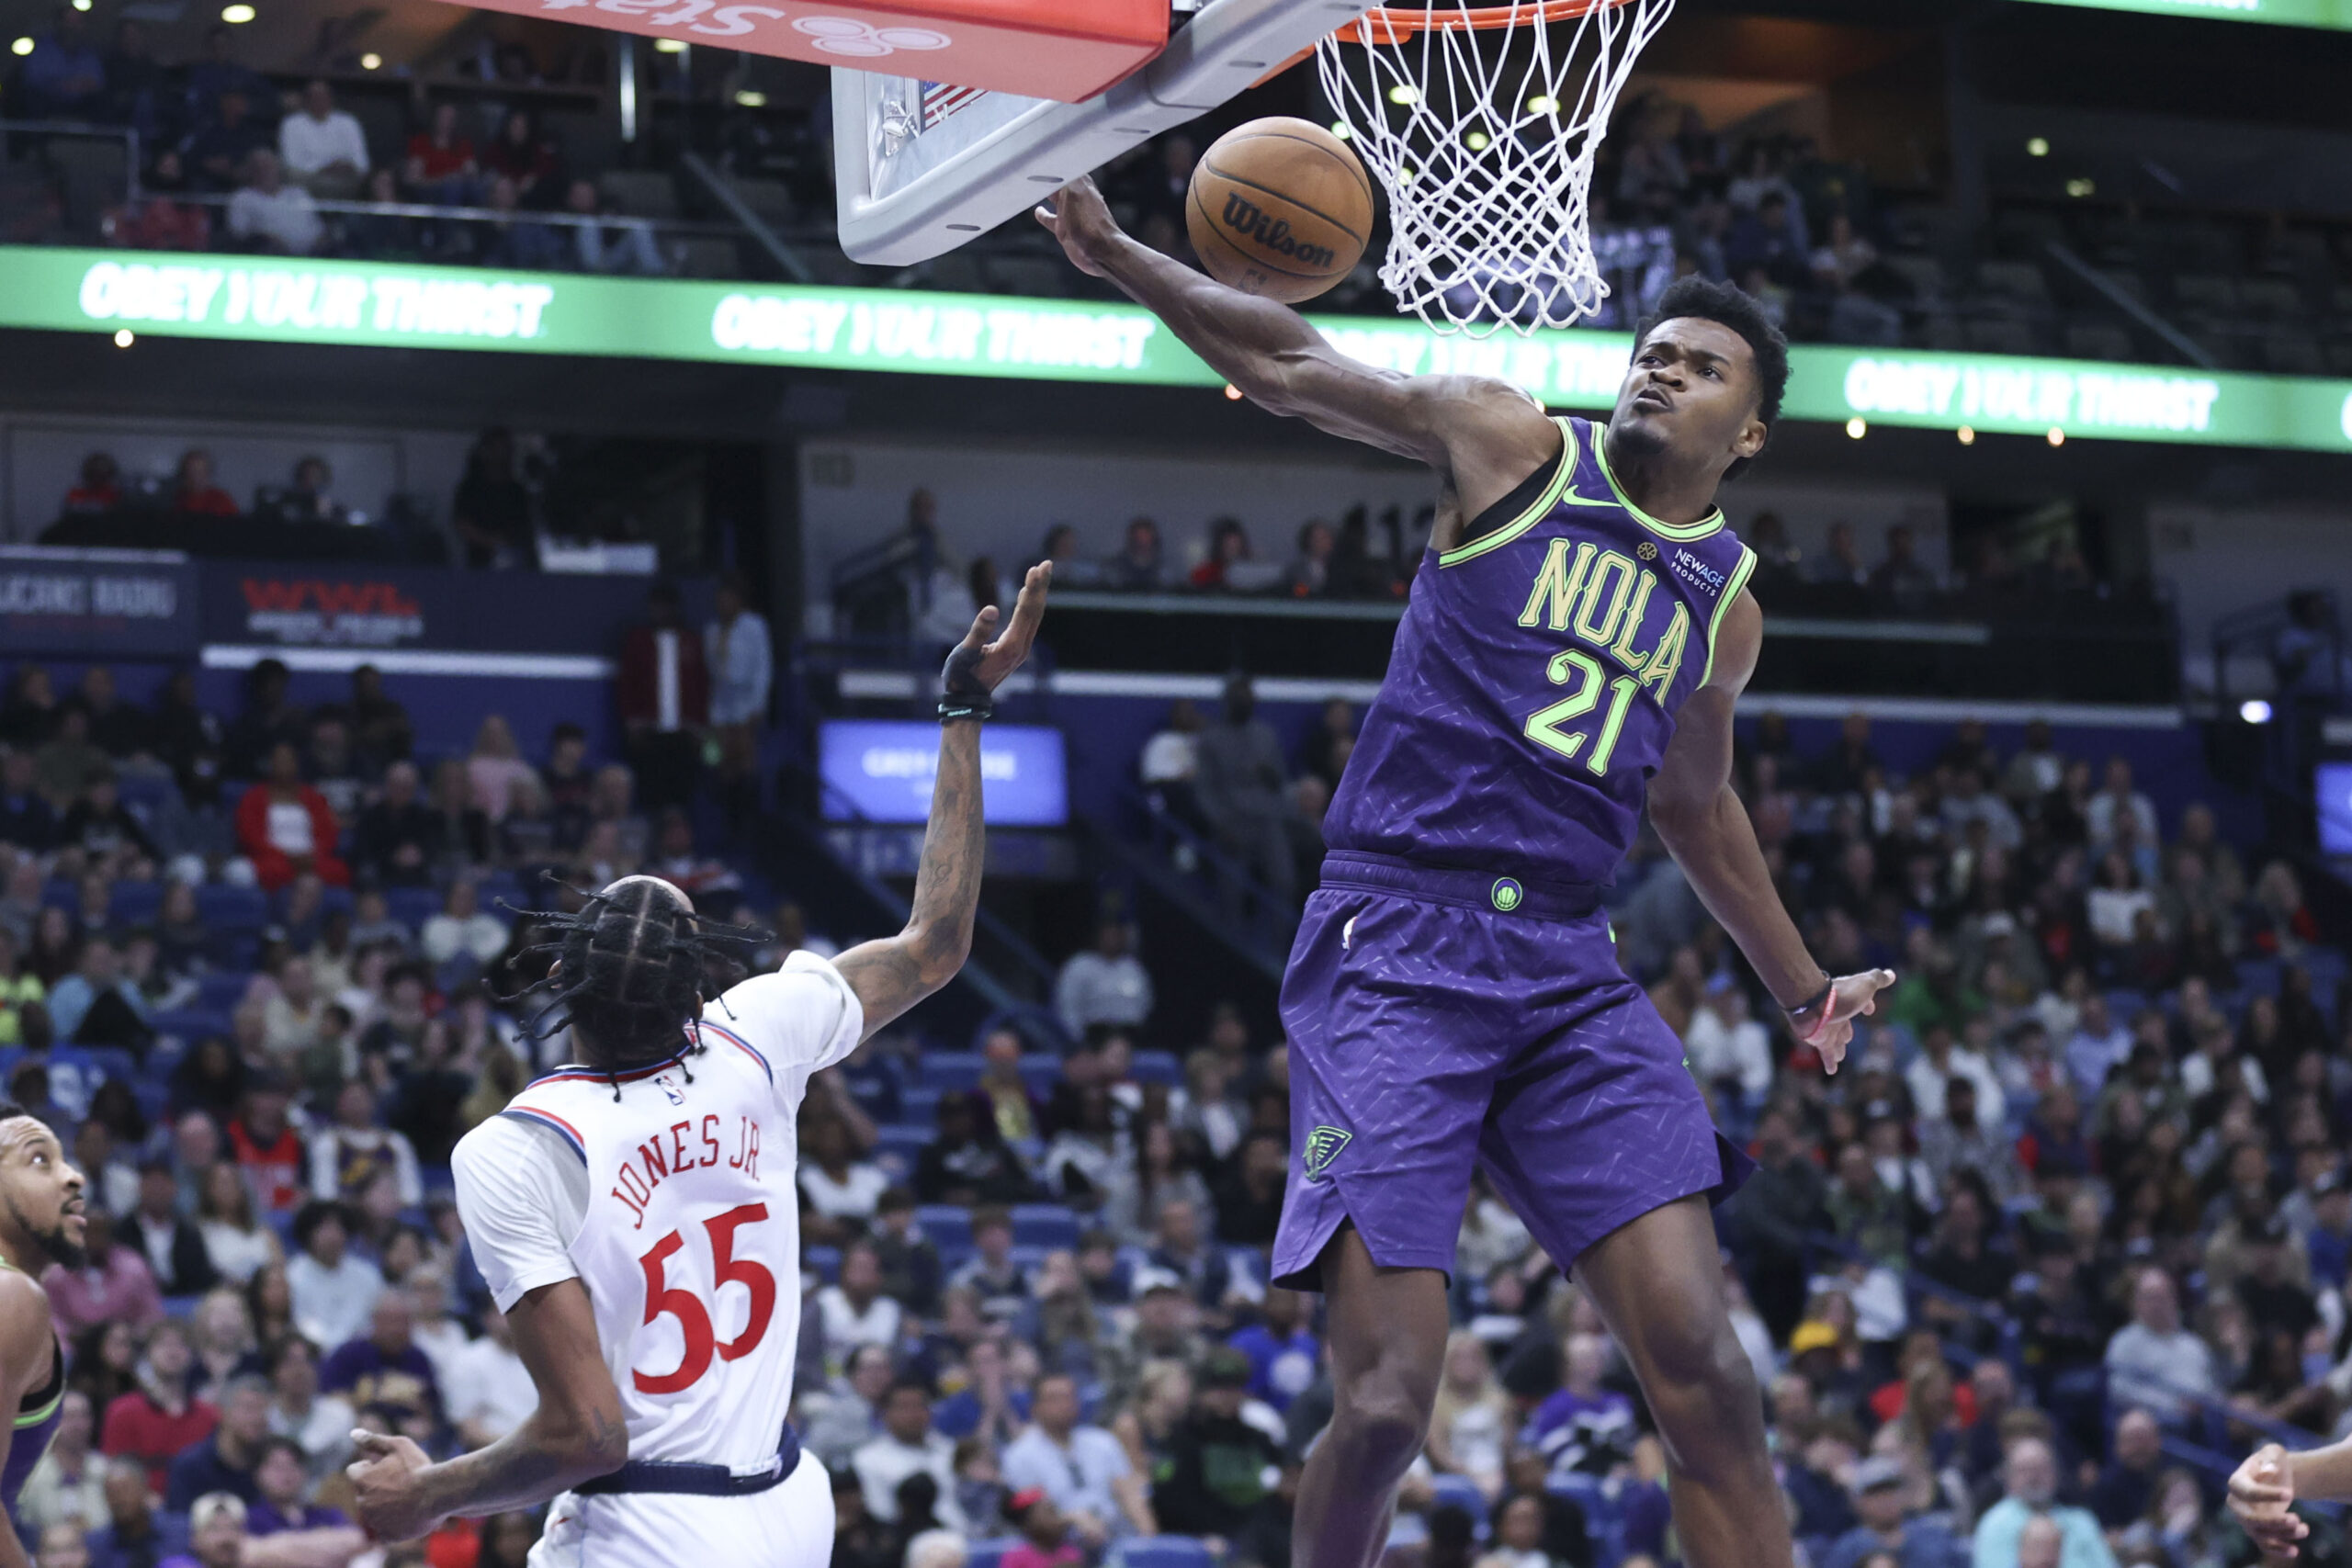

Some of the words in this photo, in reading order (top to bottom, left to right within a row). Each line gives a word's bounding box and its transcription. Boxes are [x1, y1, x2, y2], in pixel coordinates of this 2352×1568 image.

[1223, 190, 1335, 268] Wilson
[79, 261, 223, 323] OBEY
[371, 278, 553, 338] THIRST
[711, 293, 849, 354] OBEY
[984, 310, 1155, 369] THIRST
[1844, 356, 1961, 417] OBEY
[2075, 373, 2220, 432] THIRST
[1670, 561, 1717, 597] PRODUCTS
[1675, 547, 1725, 588] NEWAGE
[1518, 537, 1690, 708] NOLA
[1524, 648, 1642, 777] 21
[611, 1114, 719, 1230] JONES
[631, 1201, 776, 1394] 55
